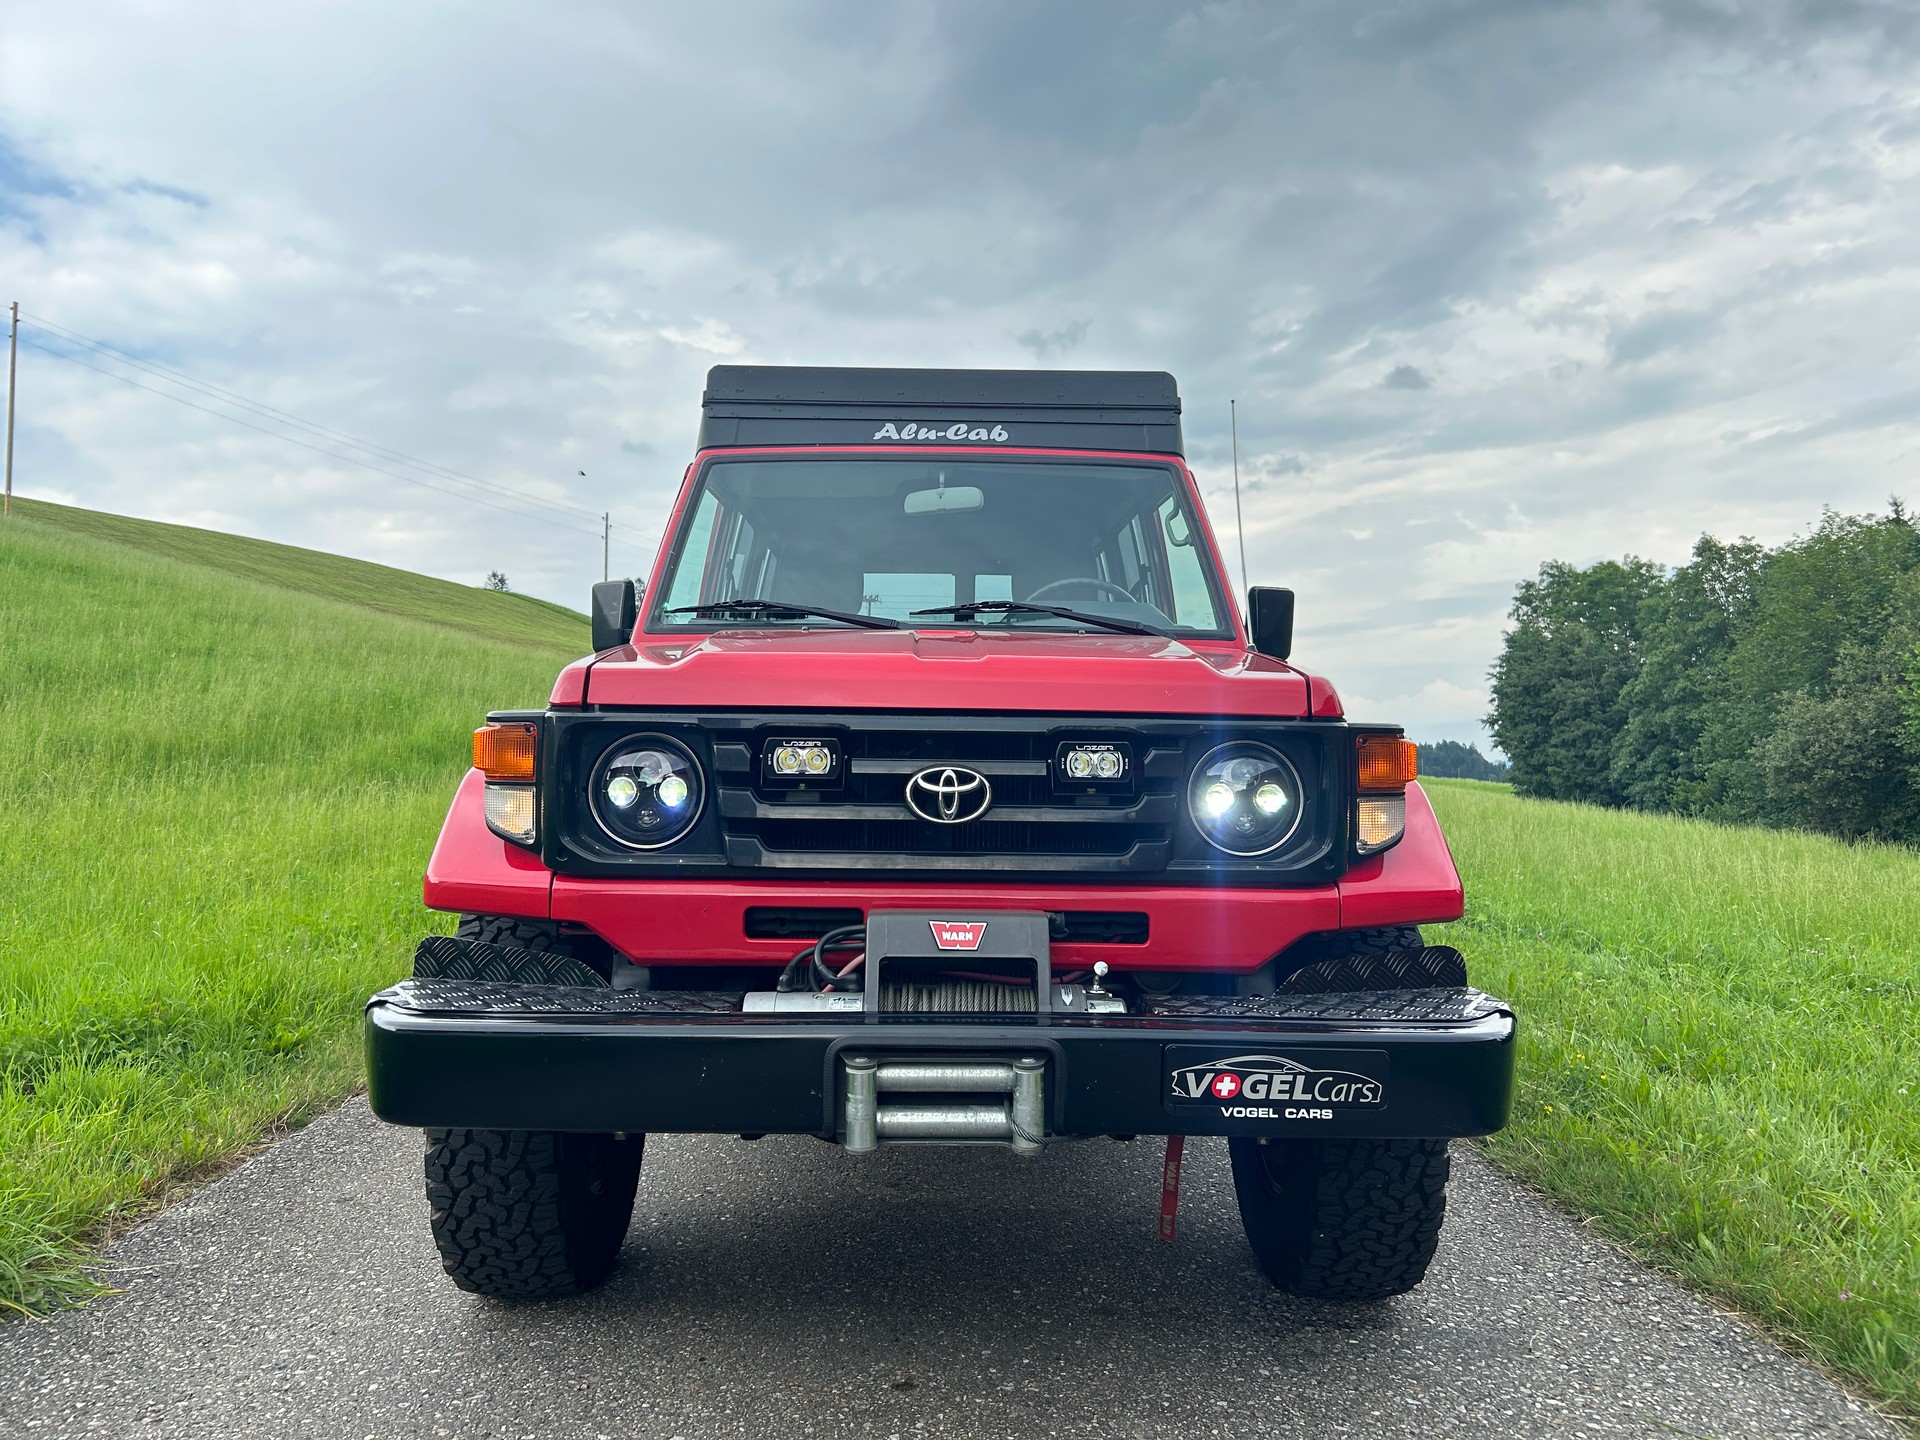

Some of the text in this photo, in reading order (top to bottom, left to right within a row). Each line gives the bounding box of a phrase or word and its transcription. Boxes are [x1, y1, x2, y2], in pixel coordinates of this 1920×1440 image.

[873, 423, 1009, 442] Alu-Cab
[942, 931, 973, 941] WARN
[1314, 1077, 1375, 1103] Cars
[1221, 1107, 1333, 1119] VOGEL CARS
